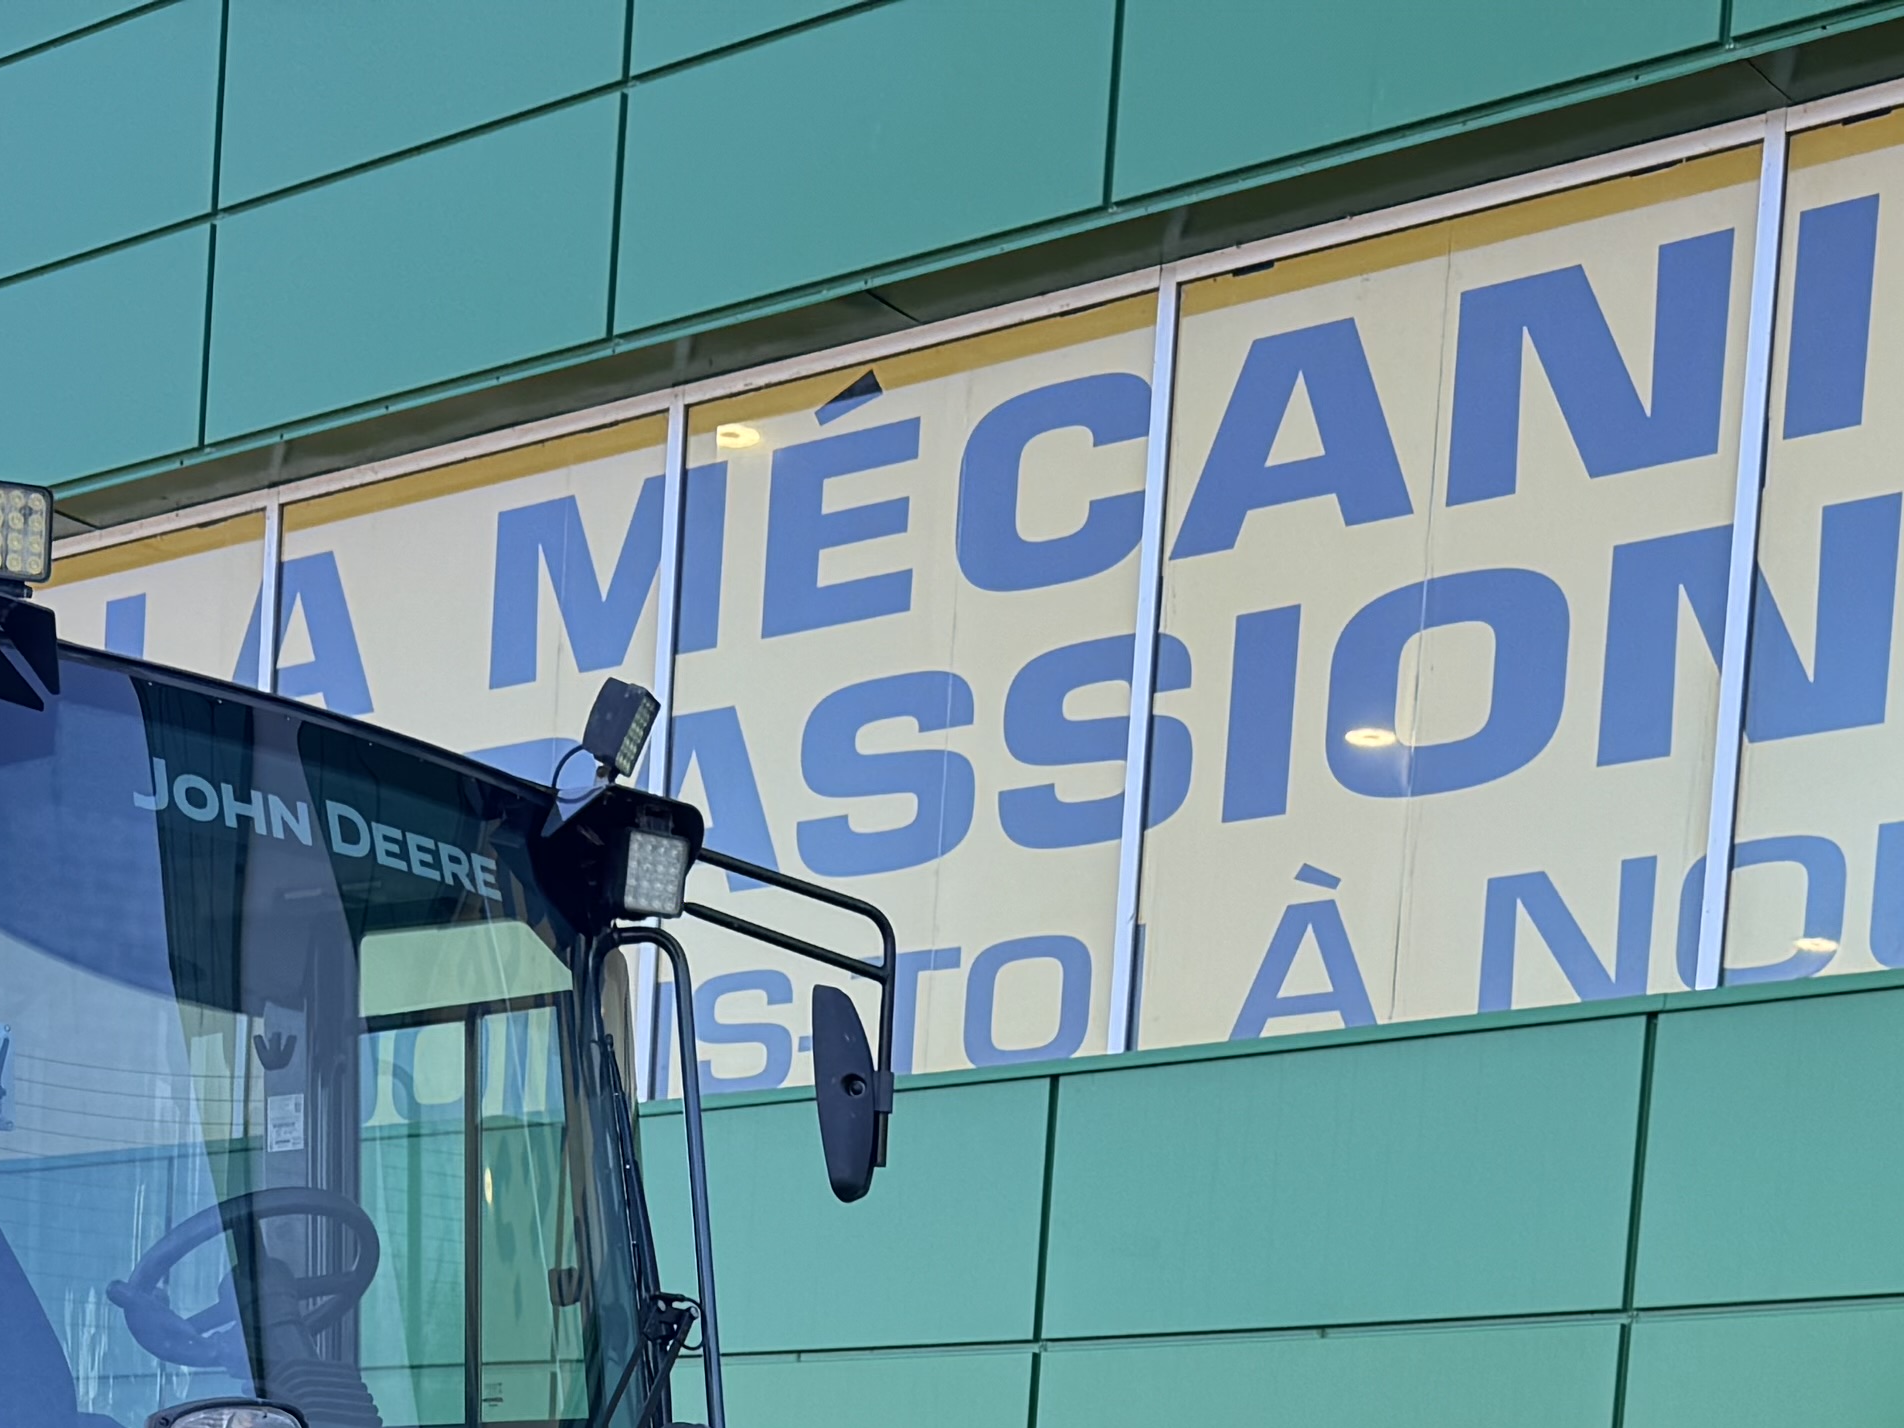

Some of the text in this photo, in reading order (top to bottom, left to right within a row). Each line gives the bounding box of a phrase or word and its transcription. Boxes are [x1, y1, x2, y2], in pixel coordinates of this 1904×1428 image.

[133, 757, 503, 901] JOHN DEERE
[1228, 863, 1378, 1041] À
